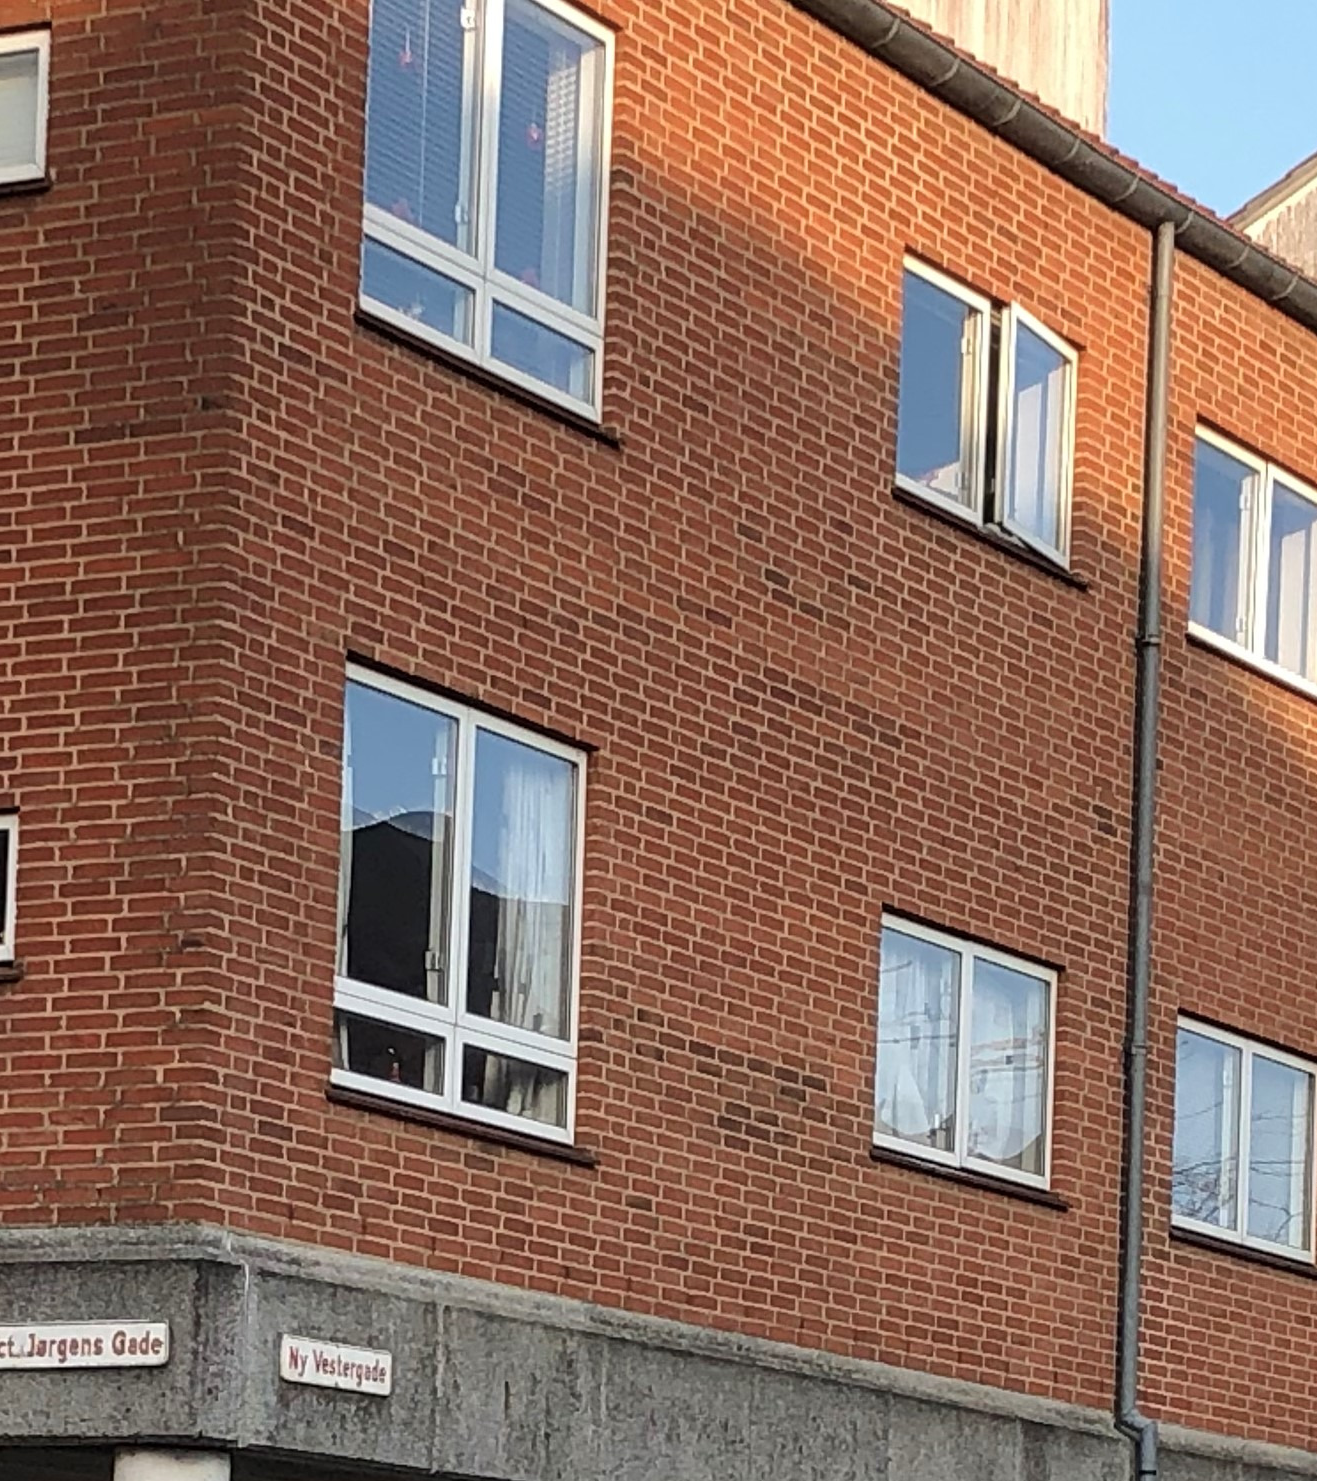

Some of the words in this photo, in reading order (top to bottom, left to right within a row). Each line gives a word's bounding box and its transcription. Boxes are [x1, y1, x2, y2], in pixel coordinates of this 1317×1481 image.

[28, 1333, 104, 1364] Jørgens
[112, 1330, 164, 1356] Gade
[288, 1345, 308, 1377] Ny
[313, 1349, 387, 1388] Vestergade
